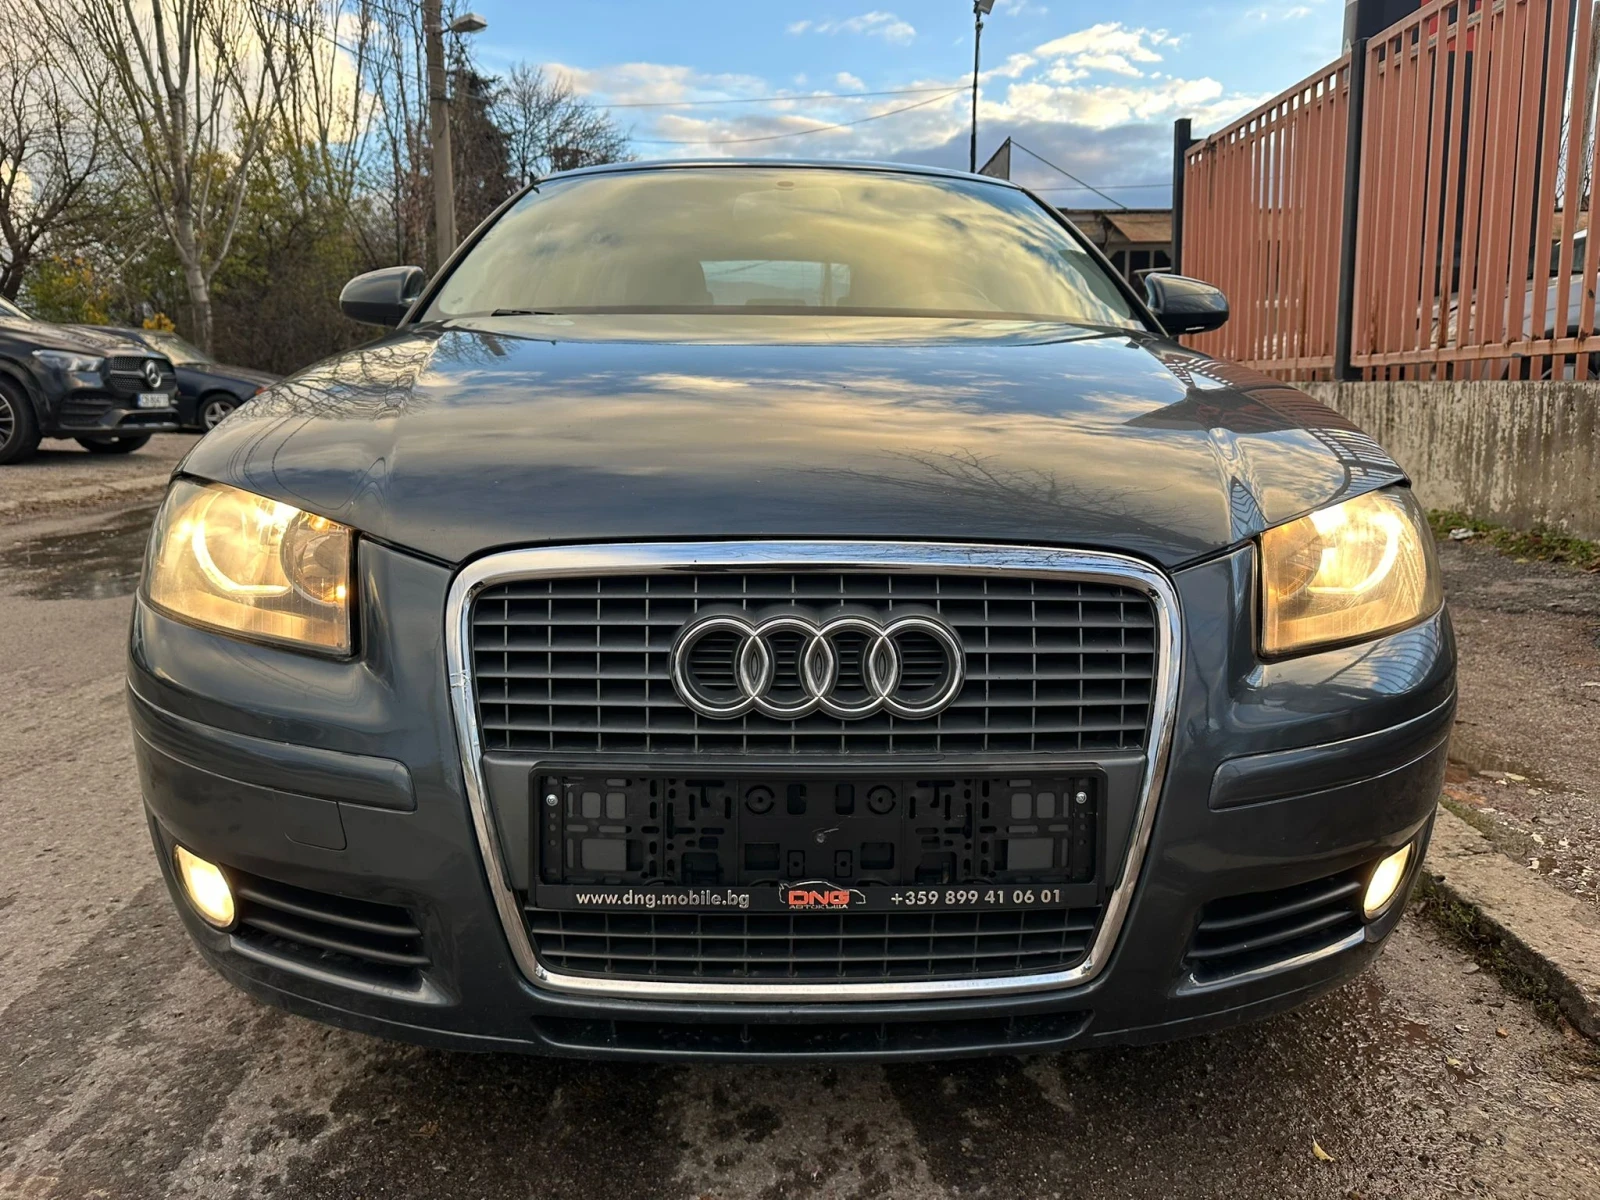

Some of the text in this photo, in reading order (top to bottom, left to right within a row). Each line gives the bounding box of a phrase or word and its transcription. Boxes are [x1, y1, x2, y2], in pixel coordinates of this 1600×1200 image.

[576, 889, 750, 909] www.dng.mobile.bg
[788, 890, 850, 905] DNG
[890, 889, 1060, 906] +359 899 41 06 01
